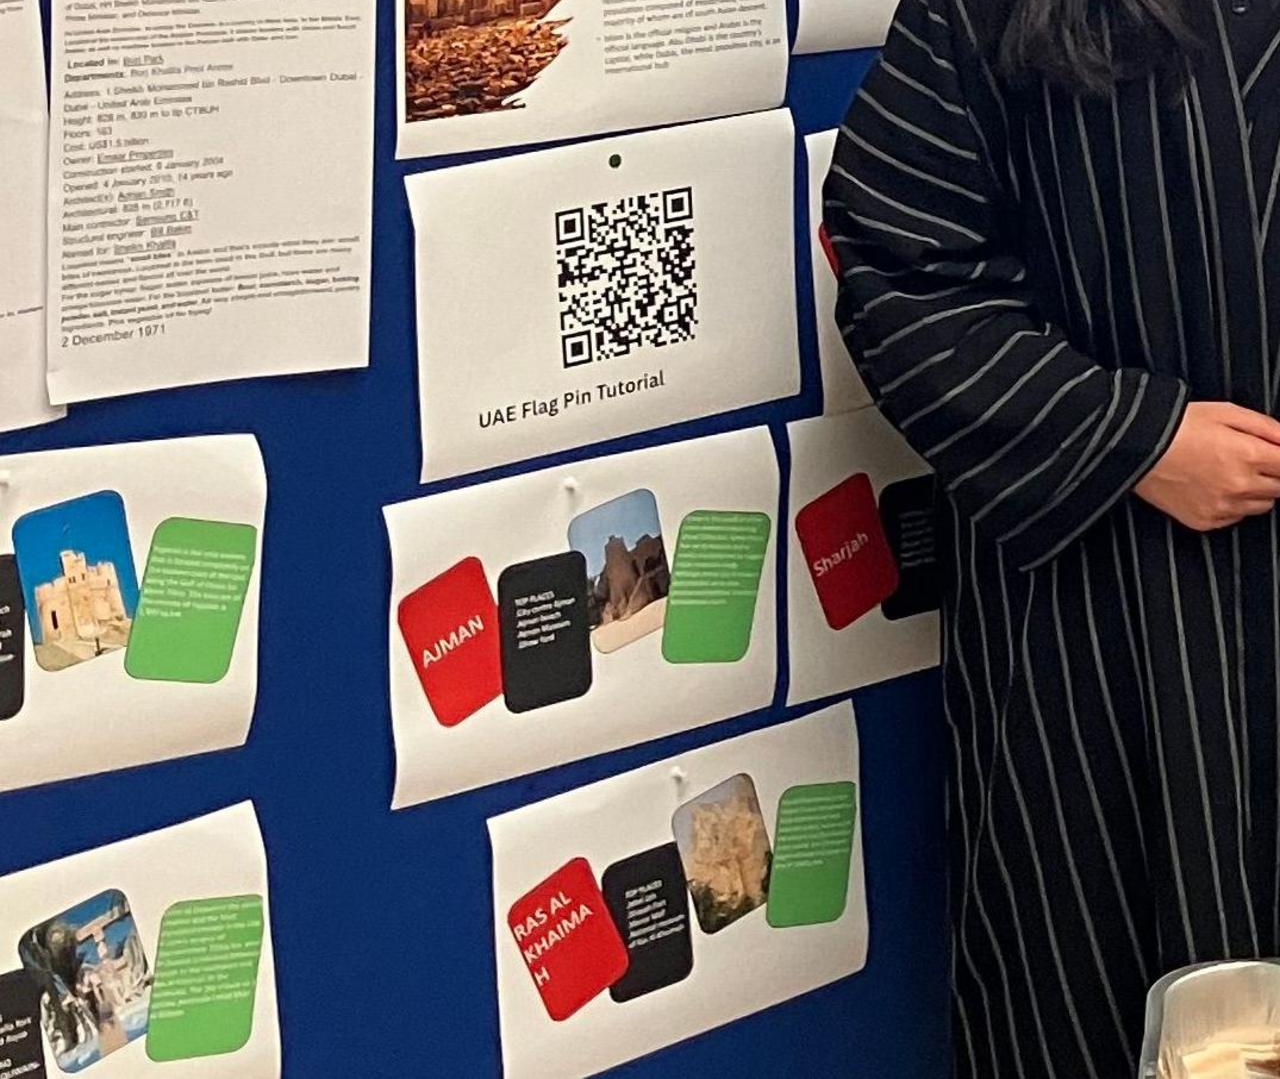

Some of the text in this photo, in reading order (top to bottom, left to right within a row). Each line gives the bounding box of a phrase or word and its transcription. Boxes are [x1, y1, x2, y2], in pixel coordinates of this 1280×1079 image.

[61, 336, 68, 348] 2
[72, 330, 134, 346] December
[478, 369, 665, 429] UAE Flag Pin Tutorial
[813, 531, 869, 577] Sharjah
[421, 613, 485, 669] AJMAN
[514, 891, 571, 941] RAS AL
[523, 903, 593, 964] KHAIMA
[534, 966, 551, 987] H
